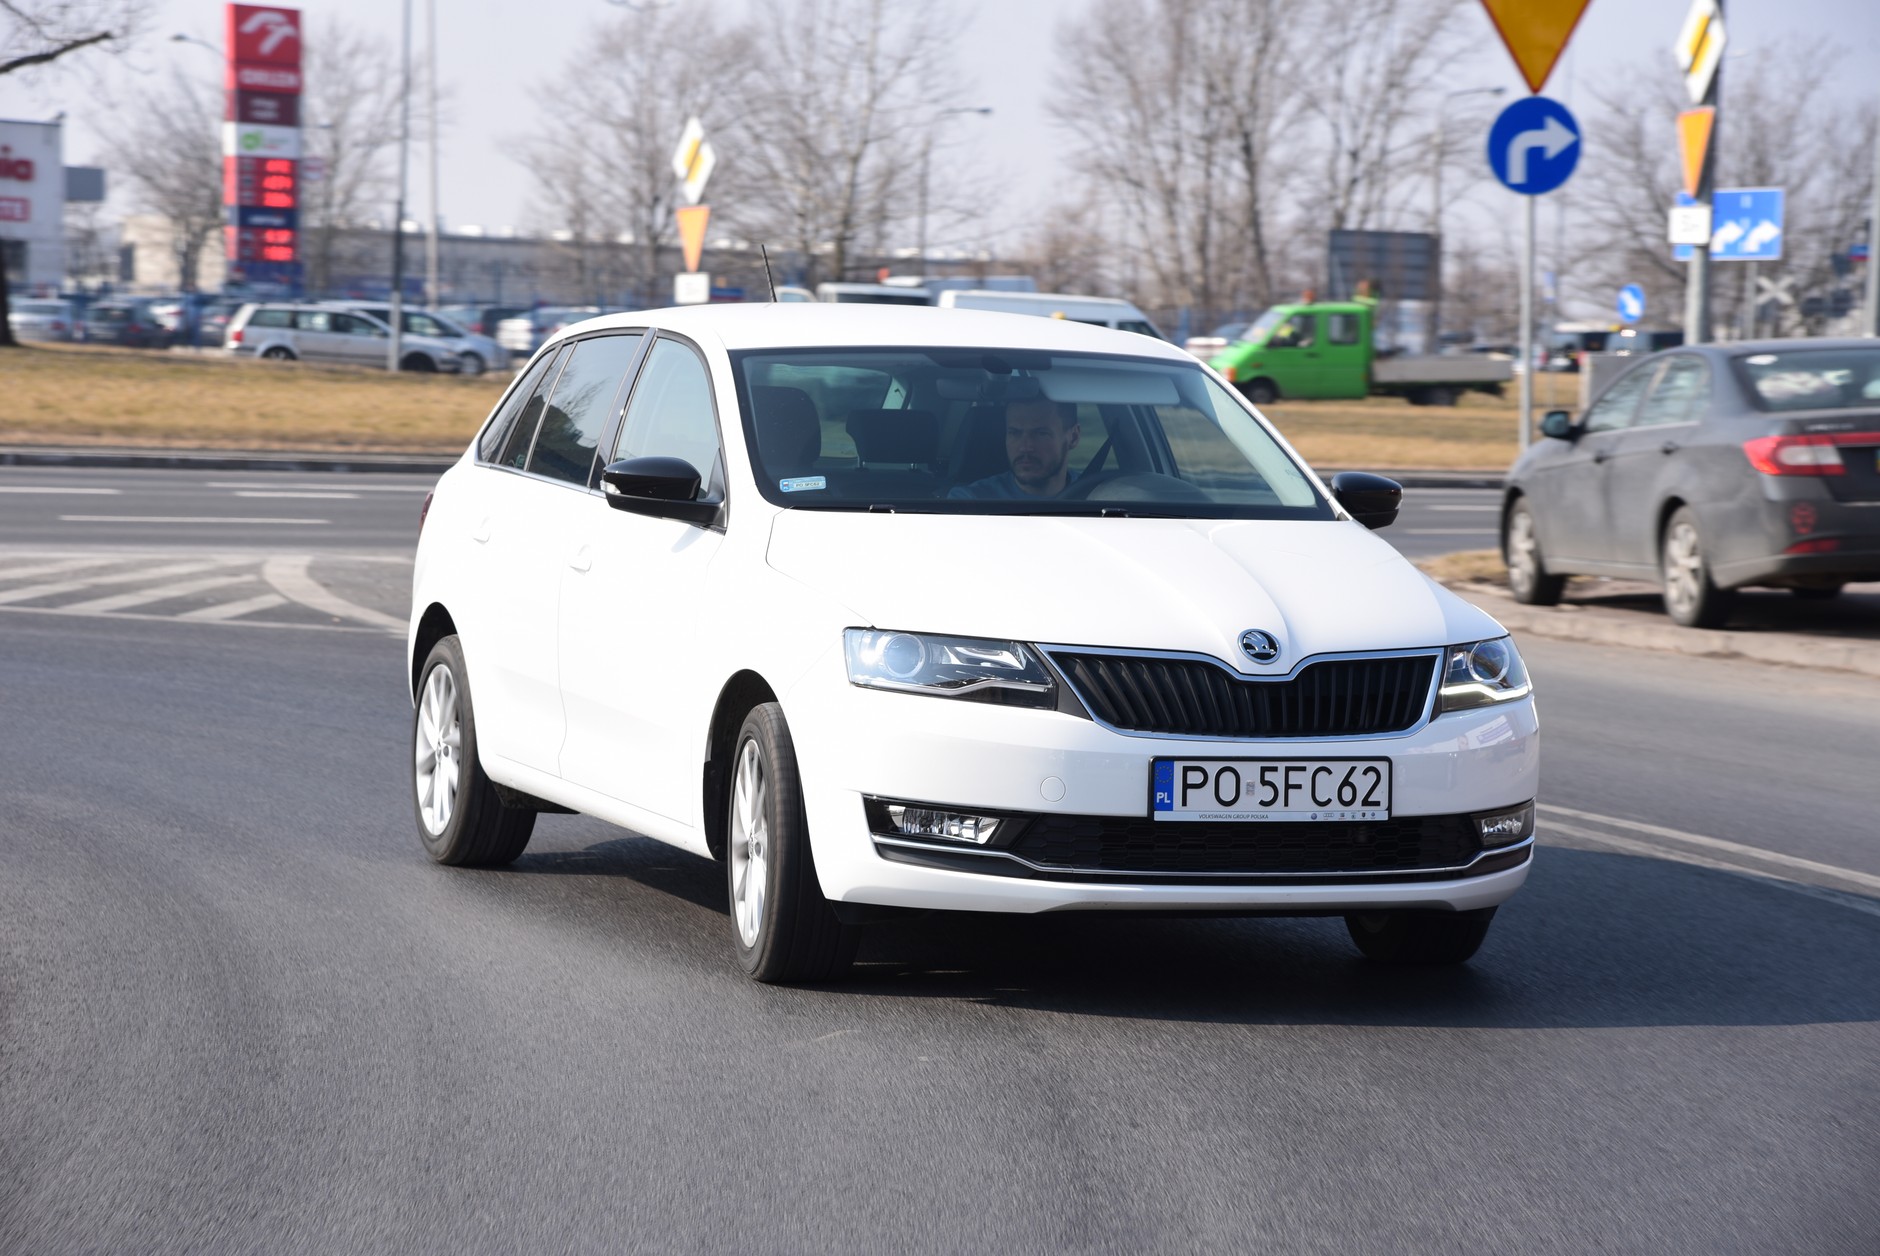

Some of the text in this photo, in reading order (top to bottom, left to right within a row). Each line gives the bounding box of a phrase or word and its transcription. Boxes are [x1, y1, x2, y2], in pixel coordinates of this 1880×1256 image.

[1156, 791, 1171, 803] PL
[1181, 765, 1382, 807] PO 5FC62
